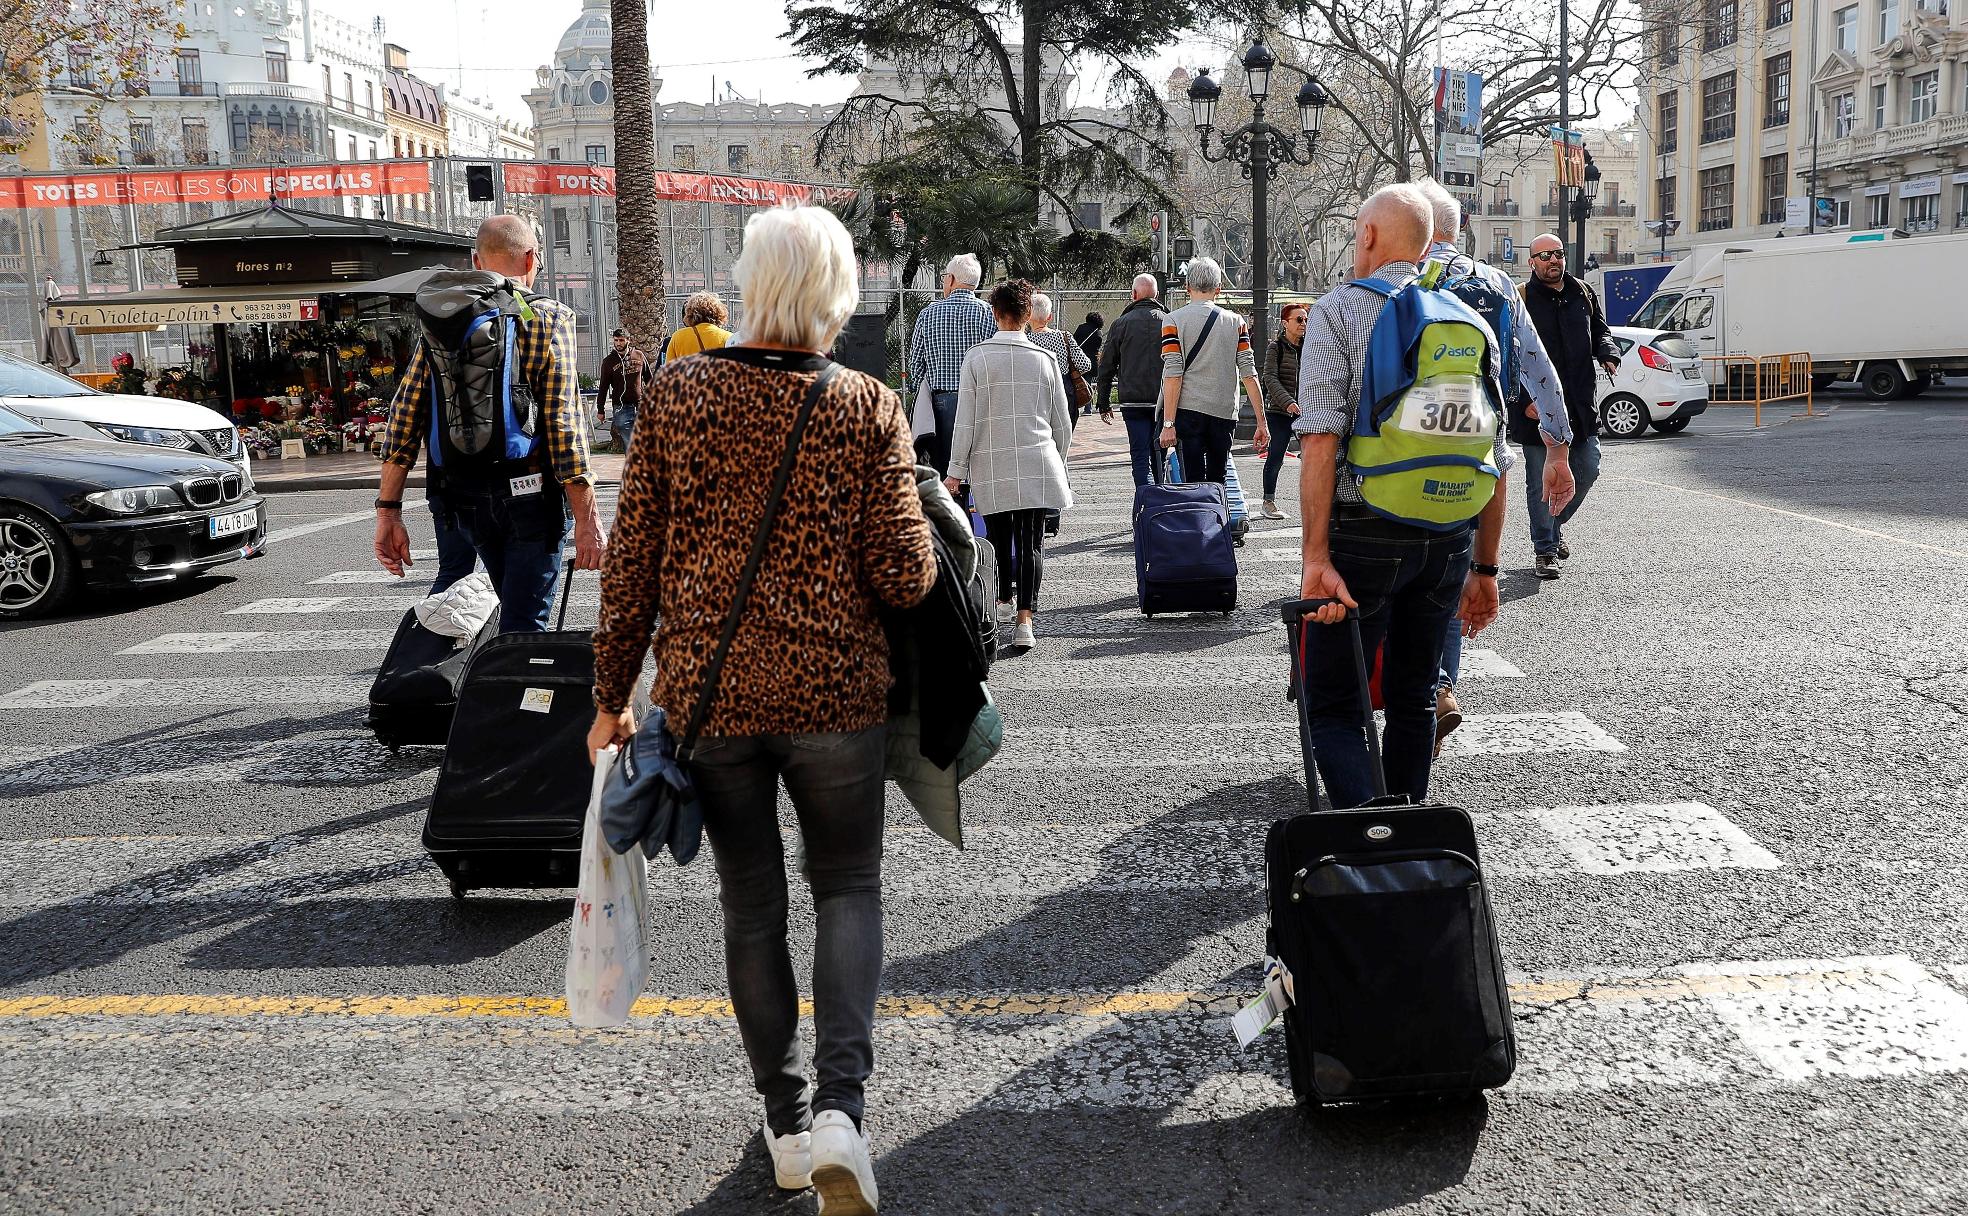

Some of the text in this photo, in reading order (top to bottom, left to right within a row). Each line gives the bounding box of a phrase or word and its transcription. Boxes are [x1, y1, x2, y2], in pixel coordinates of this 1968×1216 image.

[32, 172, 372, 201] TOTES LES FALLES SÓN ESPECIALS
[556, 174, 607, 189] TOTES
[711, 184, 776, 201] ESPECIALS
[1504, 239, 1511, 257] P
[236, 261, 270, 272] flores
[244, 302, 291, 312] 963 521 399
[306, 306, 314, 319] 2
[67, 311, 89, 325] La
[261, 312, 276, 320] 286
[16, 513, 56, 545] DUNLOP
[1371, 828, 1388, 836] SOHO
